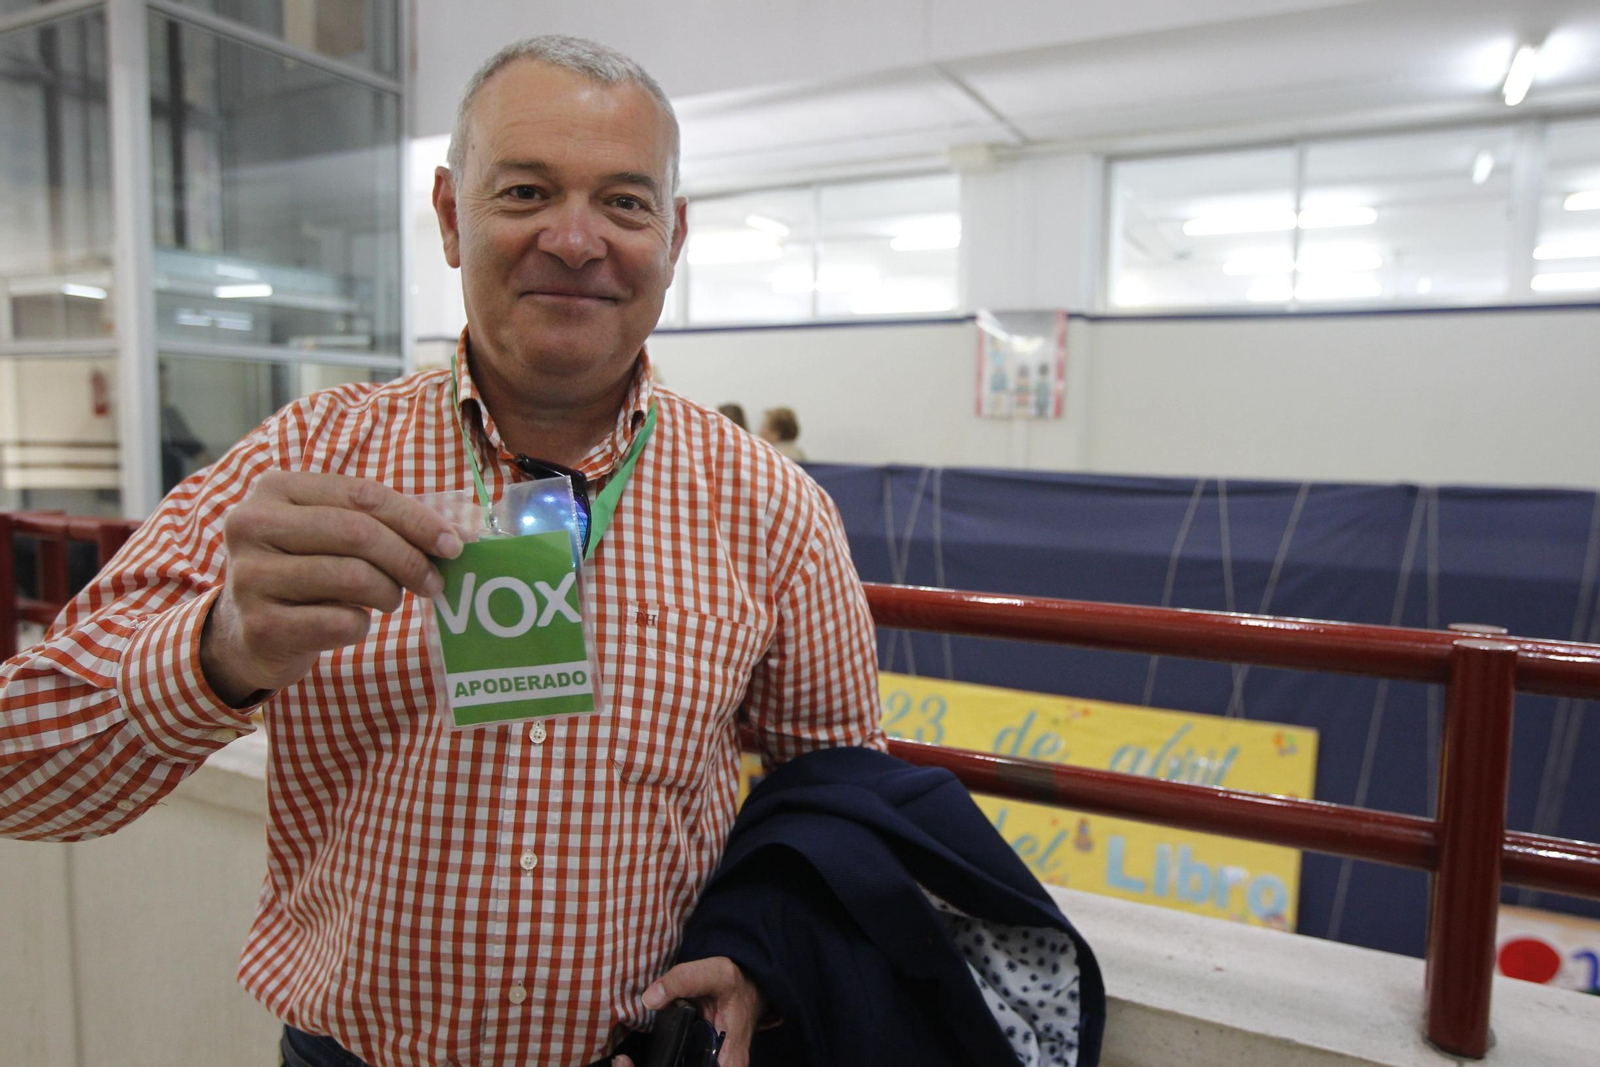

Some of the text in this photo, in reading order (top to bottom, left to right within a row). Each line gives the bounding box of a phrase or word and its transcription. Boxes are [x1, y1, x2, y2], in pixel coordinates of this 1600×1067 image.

[434, 572, 582, 638] VOX
[454, 670, 588, 698] APODERADO
[884, 690, 947, 745] 23
[993, 711, 1070, 762] de
